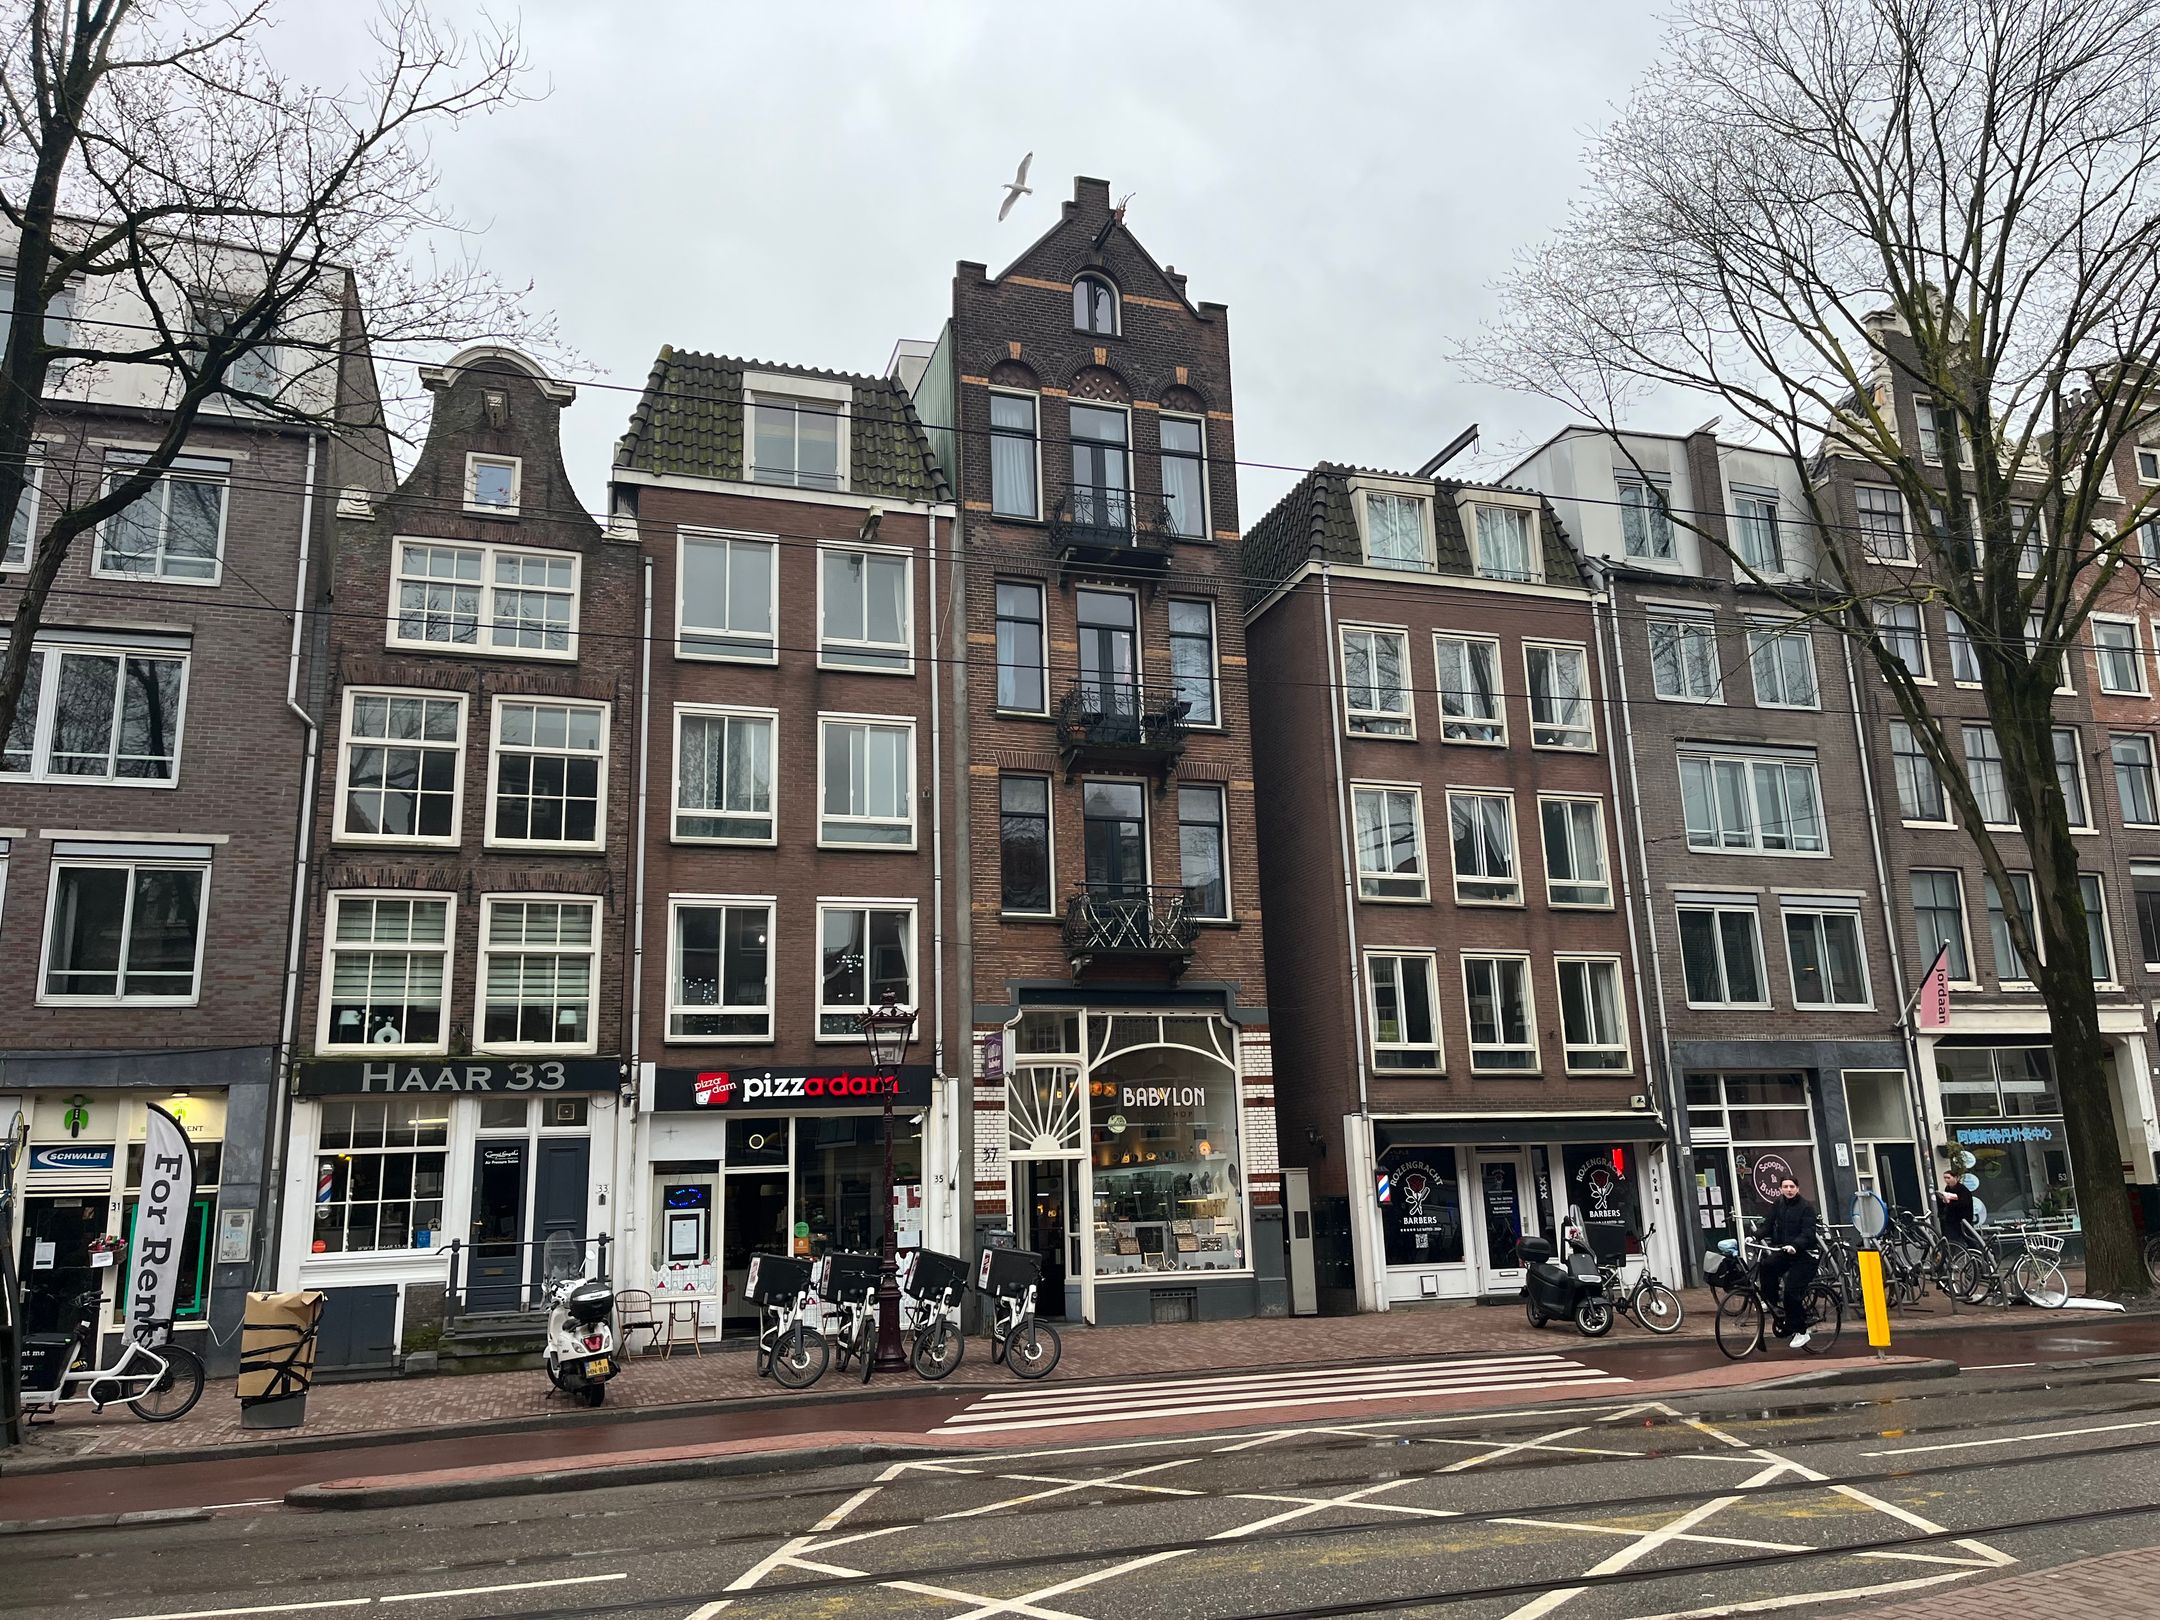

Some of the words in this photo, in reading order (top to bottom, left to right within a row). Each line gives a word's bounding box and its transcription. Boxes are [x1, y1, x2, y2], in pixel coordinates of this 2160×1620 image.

[1936, 968, 1948, 1024] Jordaan
[360, 1062, 492, 1092] HAAR
[505, 1061, 566, 1091] 33
[712, 1080, 737, 1094] dam
[1123, 1087, 1206, 1107] BABYLON
[49, 1152, 108, 1161] SCHWALBE
[982, 1147, 999, 1163] 37
[934, 1174, 944, 1184] 35
[1390, 1160, 1444, 1187] ROZENGRACHT
[2058, 1173, 2068, 1181] 53
[147, 1154, 183, 1225] For
[598, 1183, 609, 1193] 33
[111, 1202, 121, 1212] 31
[1589, 1209, 1621, 1218] BARBERS
[1403, 1216, 1438, 1225] BARBERS
[132, 1237, 172, 1344] Rent
